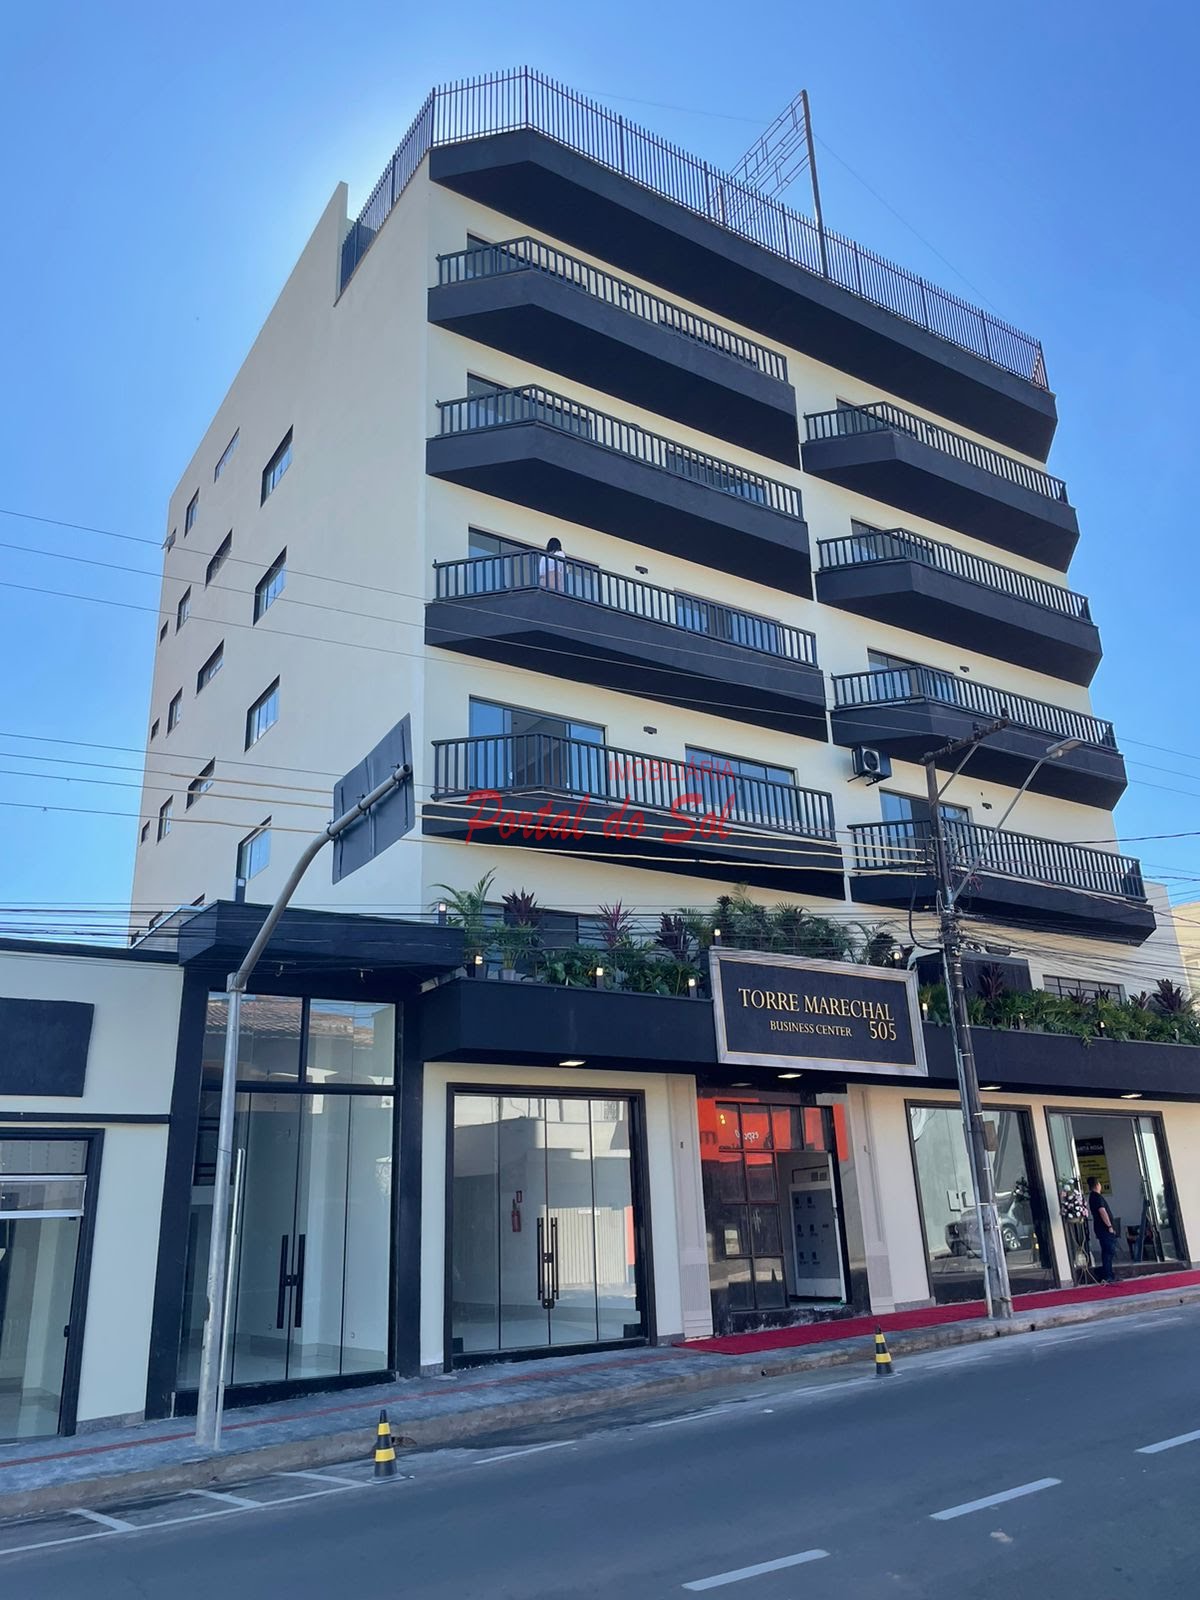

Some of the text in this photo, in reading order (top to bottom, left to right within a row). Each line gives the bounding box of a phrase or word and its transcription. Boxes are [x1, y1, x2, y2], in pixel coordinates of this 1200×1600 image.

[738, 987, 895, 1021] TORRE MARECHAL
[770, 1020, 852, 1037] BUSINESS CENTER
[870, 1021, 897, 1041] 505
